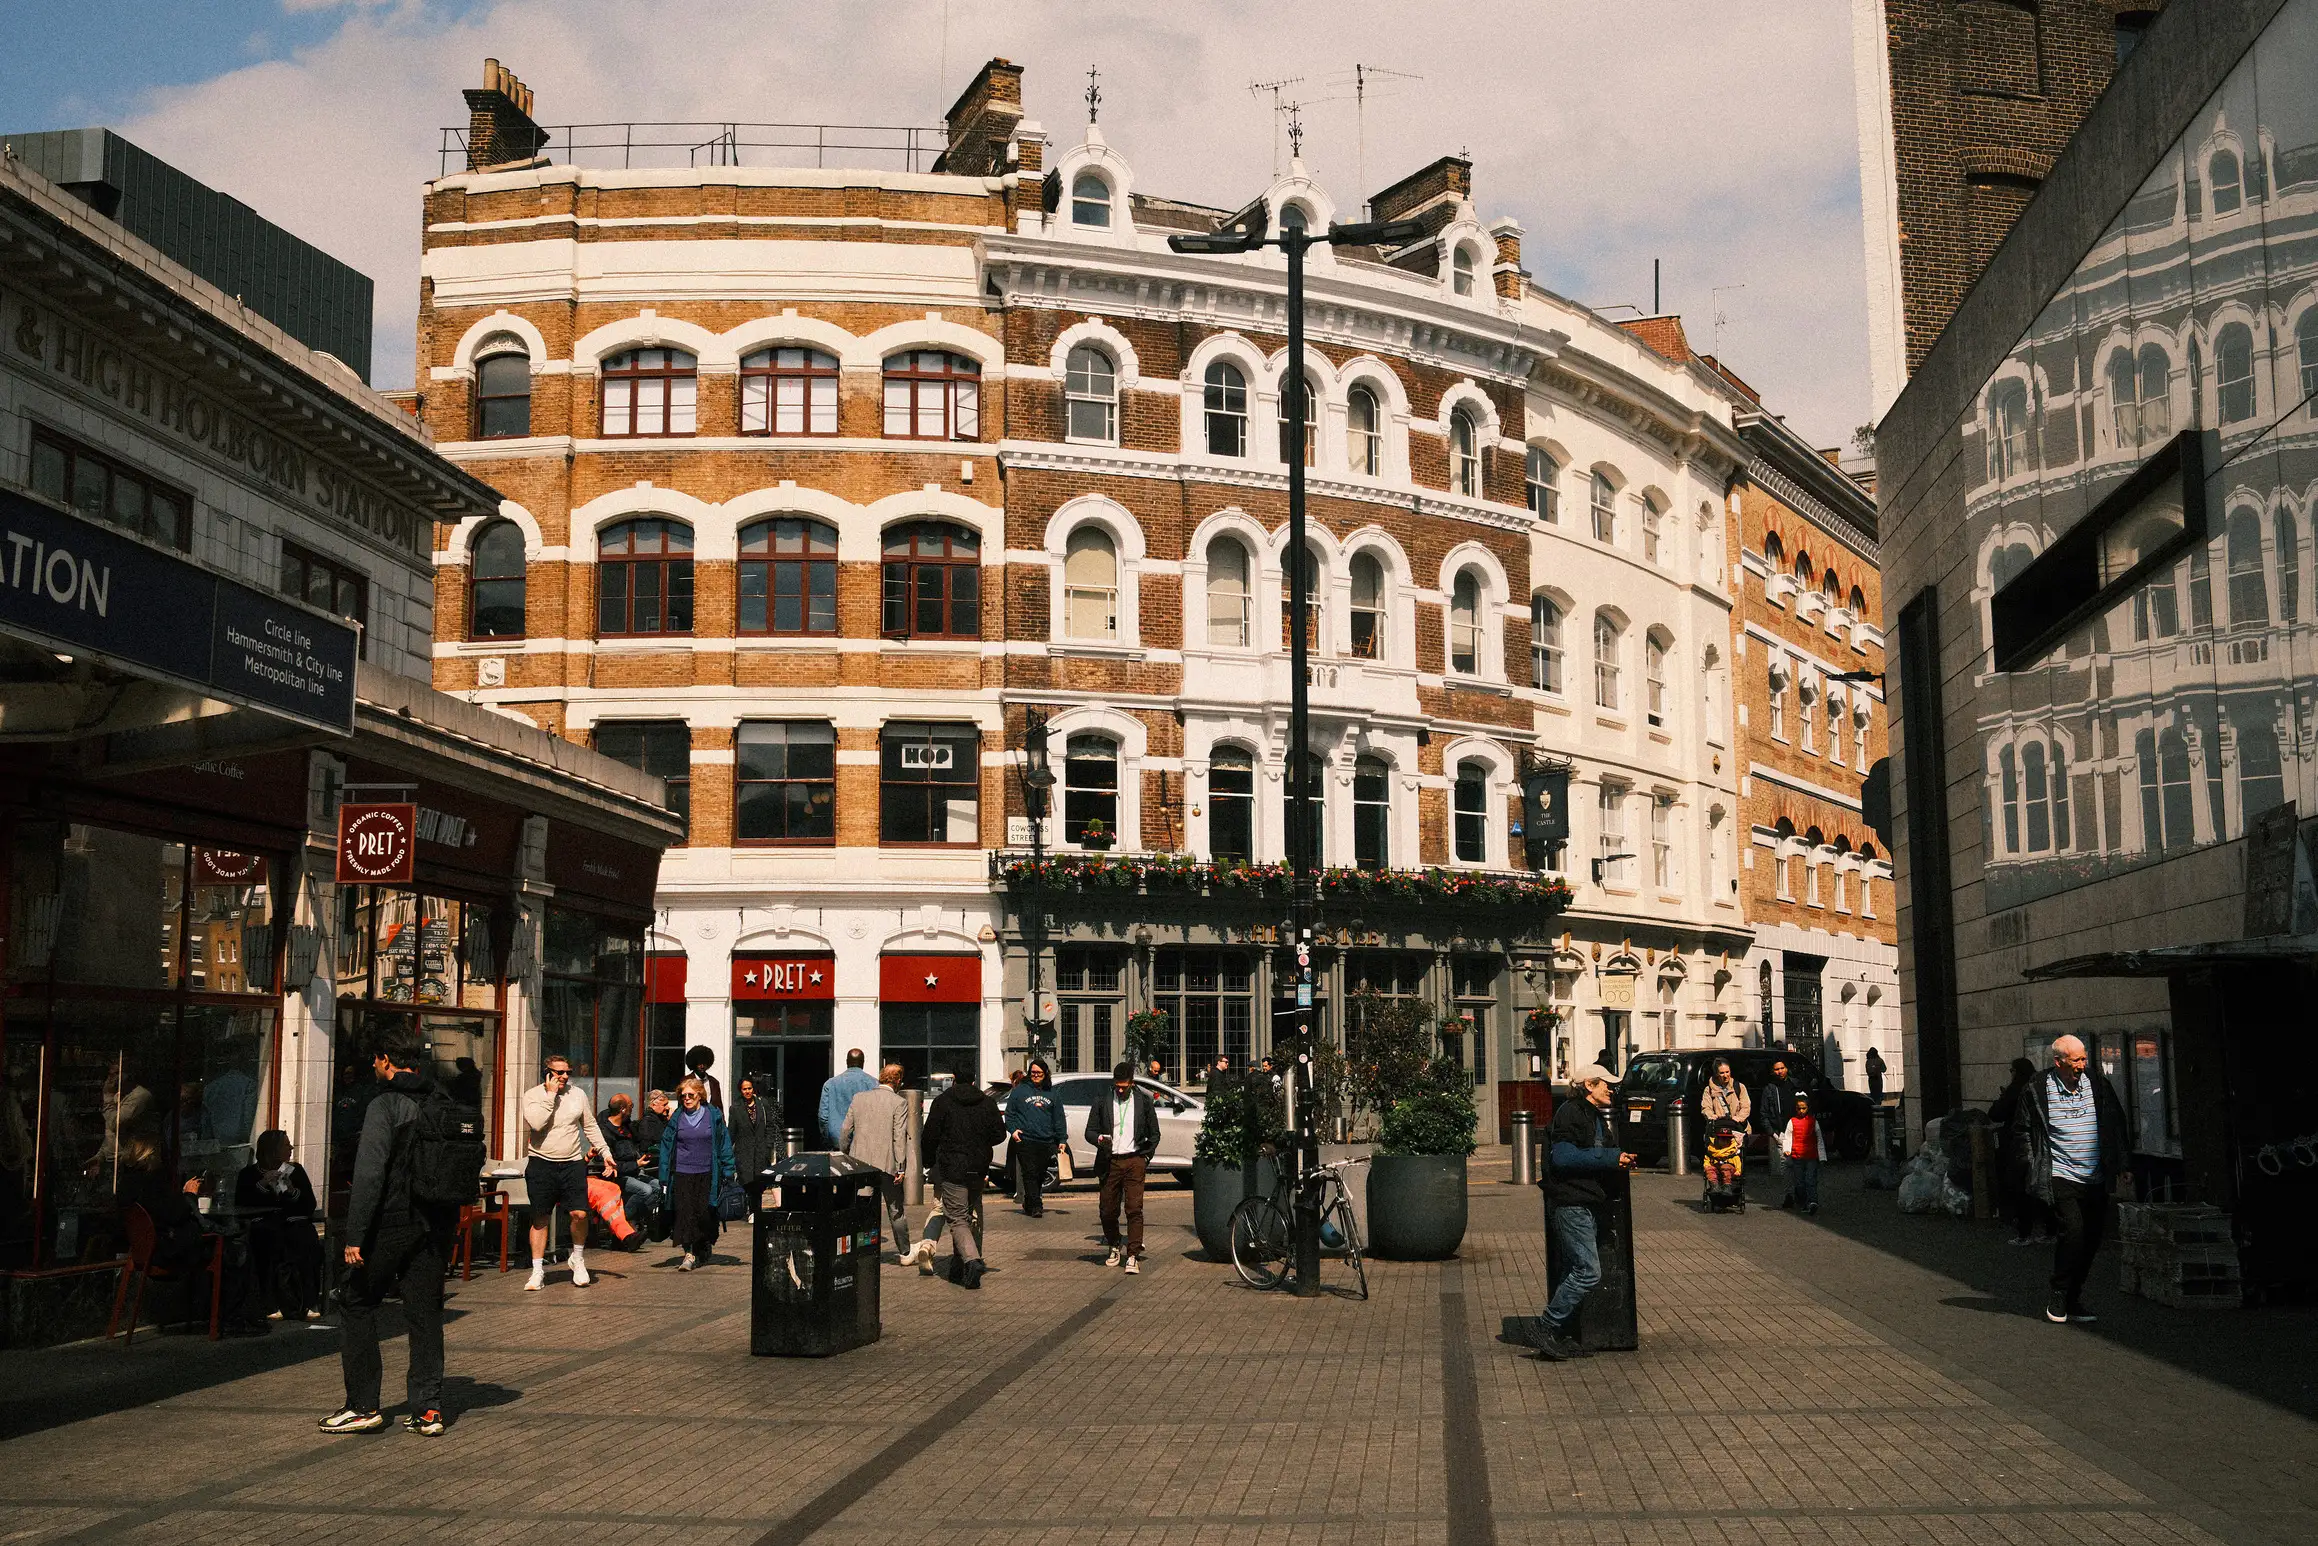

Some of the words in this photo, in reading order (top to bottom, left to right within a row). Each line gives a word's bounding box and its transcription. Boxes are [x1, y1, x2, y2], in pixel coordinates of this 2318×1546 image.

[16, 304, 44, 361] &
[55, 323, 152, 417] HIGH
[160, 376, 308, 495] HOLBORN
[316, 462, 415, 550] STATION
[264, 618, 292, 642] Circle
[294, 629, 311, 649] line
[226, 625, 293, 664] Hammersmith
[296, 652, 303, 668] &
[305, 656, 325, 678] City
[326, 663, 343, 682] line
[244, 655, 305, 690] Metropolitan
[308, 677, 325, 696] line
[905, 748, 949, 764] HOP
[219, 760, 245, 780] Coffee
[348, 811, 379, 834] ORGANIC
[380, 811, 405, 833] COFFEE
[1010, 824, 1049, 833] COWGRSS
[1536, 819, 1556, 827] CASTLE
[358, 832, 395, 855] PRET
[345, 849, 369, 875] FRESHLY
[370, 865, 391, 876] MADE
[390, 848, 406, 868] FOOD
[763, 963, 806, 990] PRET
[776, 1224, 802, 1232] LITTER
